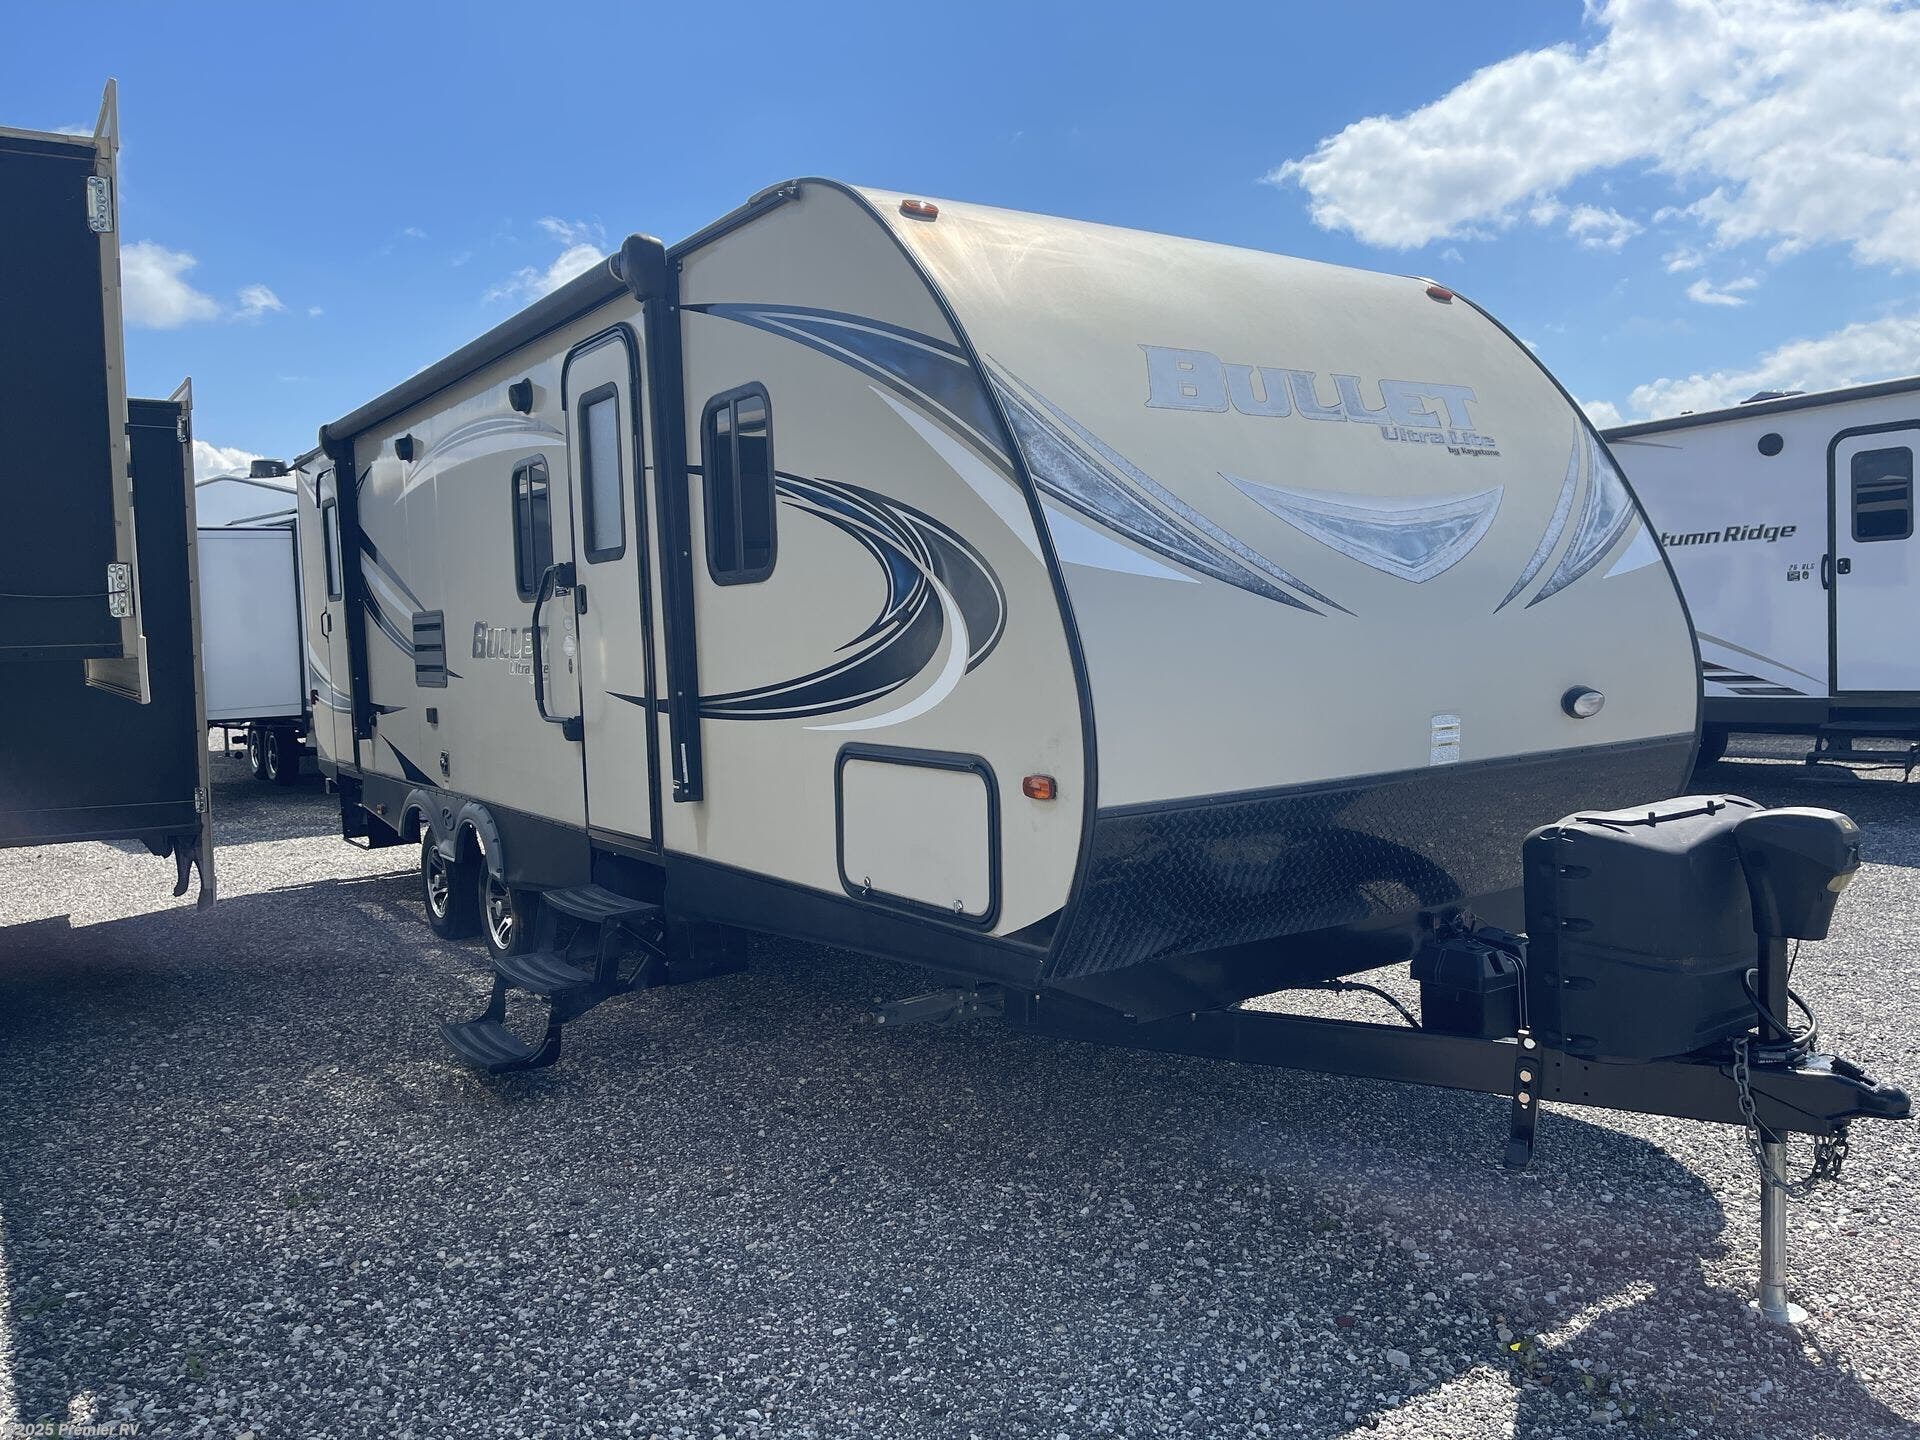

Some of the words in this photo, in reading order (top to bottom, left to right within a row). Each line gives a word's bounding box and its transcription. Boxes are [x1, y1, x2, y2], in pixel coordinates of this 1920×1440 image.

[1138, 344, 1478, 430] BULLET
[1381, 426, 1445, 445] Ultra
[1448, 430, 1496, 447] Lite
[1661, 532, 1721, 547] tumn
[1723, 524, 1797, 543] Ridge
